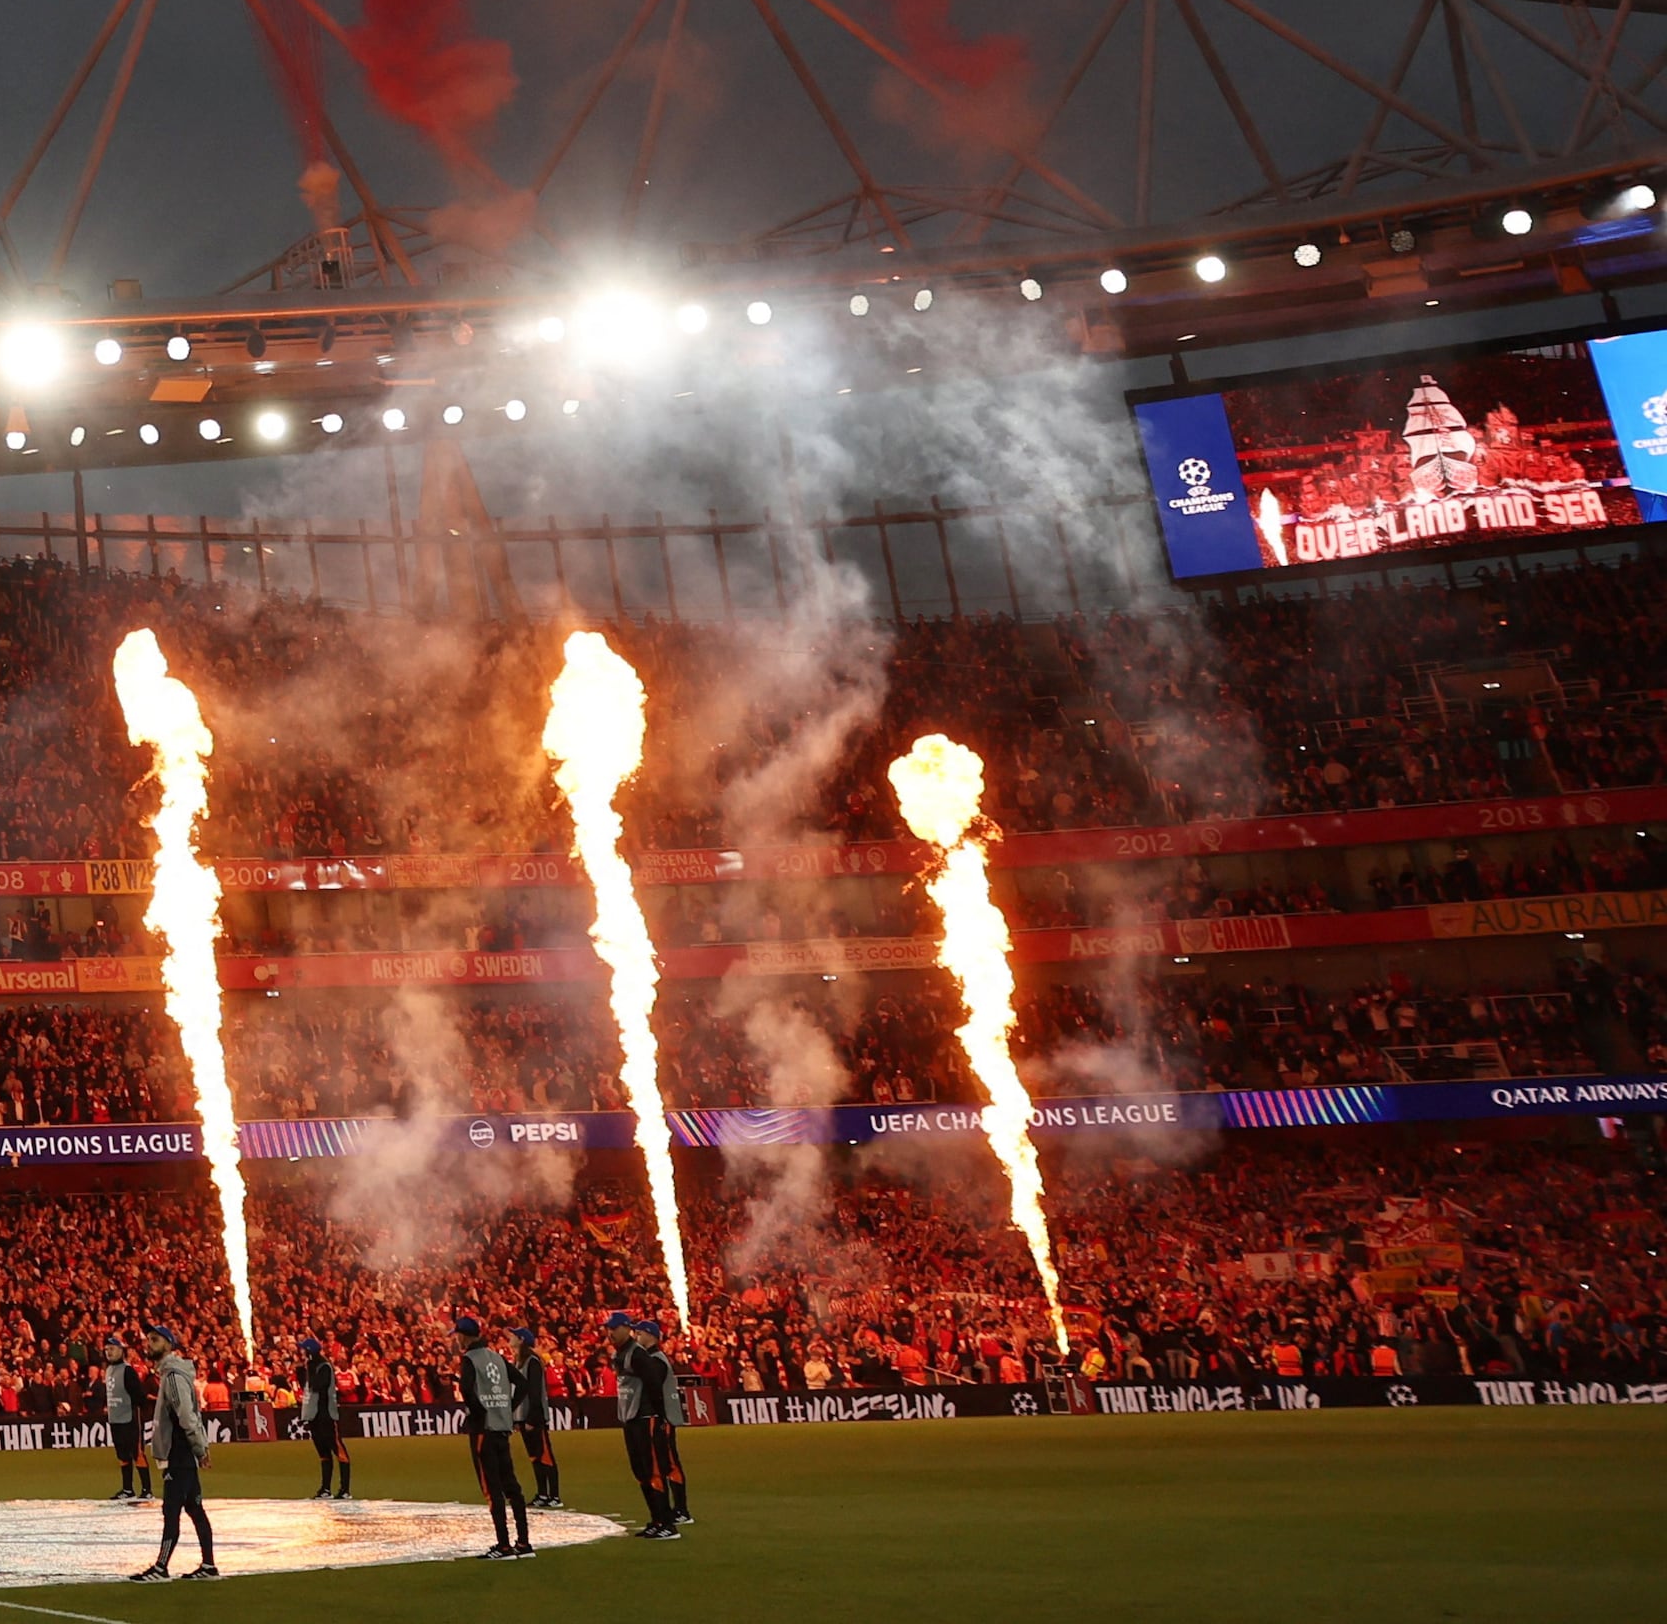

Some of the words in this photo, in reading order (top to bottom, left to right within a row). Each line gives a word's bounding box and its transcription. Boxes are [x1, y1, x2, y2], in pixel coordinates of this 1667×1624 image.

[1169, 492, 1234, 509] CHAMPIONS
[1181, 501, 1227, 515] LEAGUE
[1296, 519, 1380, 562] OVER
[1386, 499, 1467, 544] LAND
[1477, 491, 1537, 528] AND
[1549, 490, 1607, 525] SEA
[1479, 806, 1543, 828] 2013
[1116, 832, 1172, 855] 2012
[510, 861, 559, 881] 2010
[776, 854, 820, 873] 2011
[91, 862, 120, 890] P38
[223, 866, 281, 887] 2009
[1470, 890, 1667, 934] AUSTRALIA
[1068, 927, 1166, 958] Arsenal
[1211, 919, 1290, 952] CANADA
[371, 957, 443, 978] ARSENAL
[475, 955, 543, 977] SWEDEN
[751, 950, 805, 965] SOUTH
[1492, 1086, 1569, 1110] QATAR
[1574, 1082, 1667, 1105] AIRWAYS
[869, 1111, 931, 1134] UEFA
[1081, 1102, 1178, 1126] LEAGUE
[108, 1131, 194, 1154] LEAGUE
[510, 1123, 578, 1143] PEPSI
[1095, 1385, 1147, 1414] THAT
[1474, 1380, 1536, 1405] THAT
[727, 1396, 779, 1424] THAT
[358, 1410, 411, 1437] THAT
